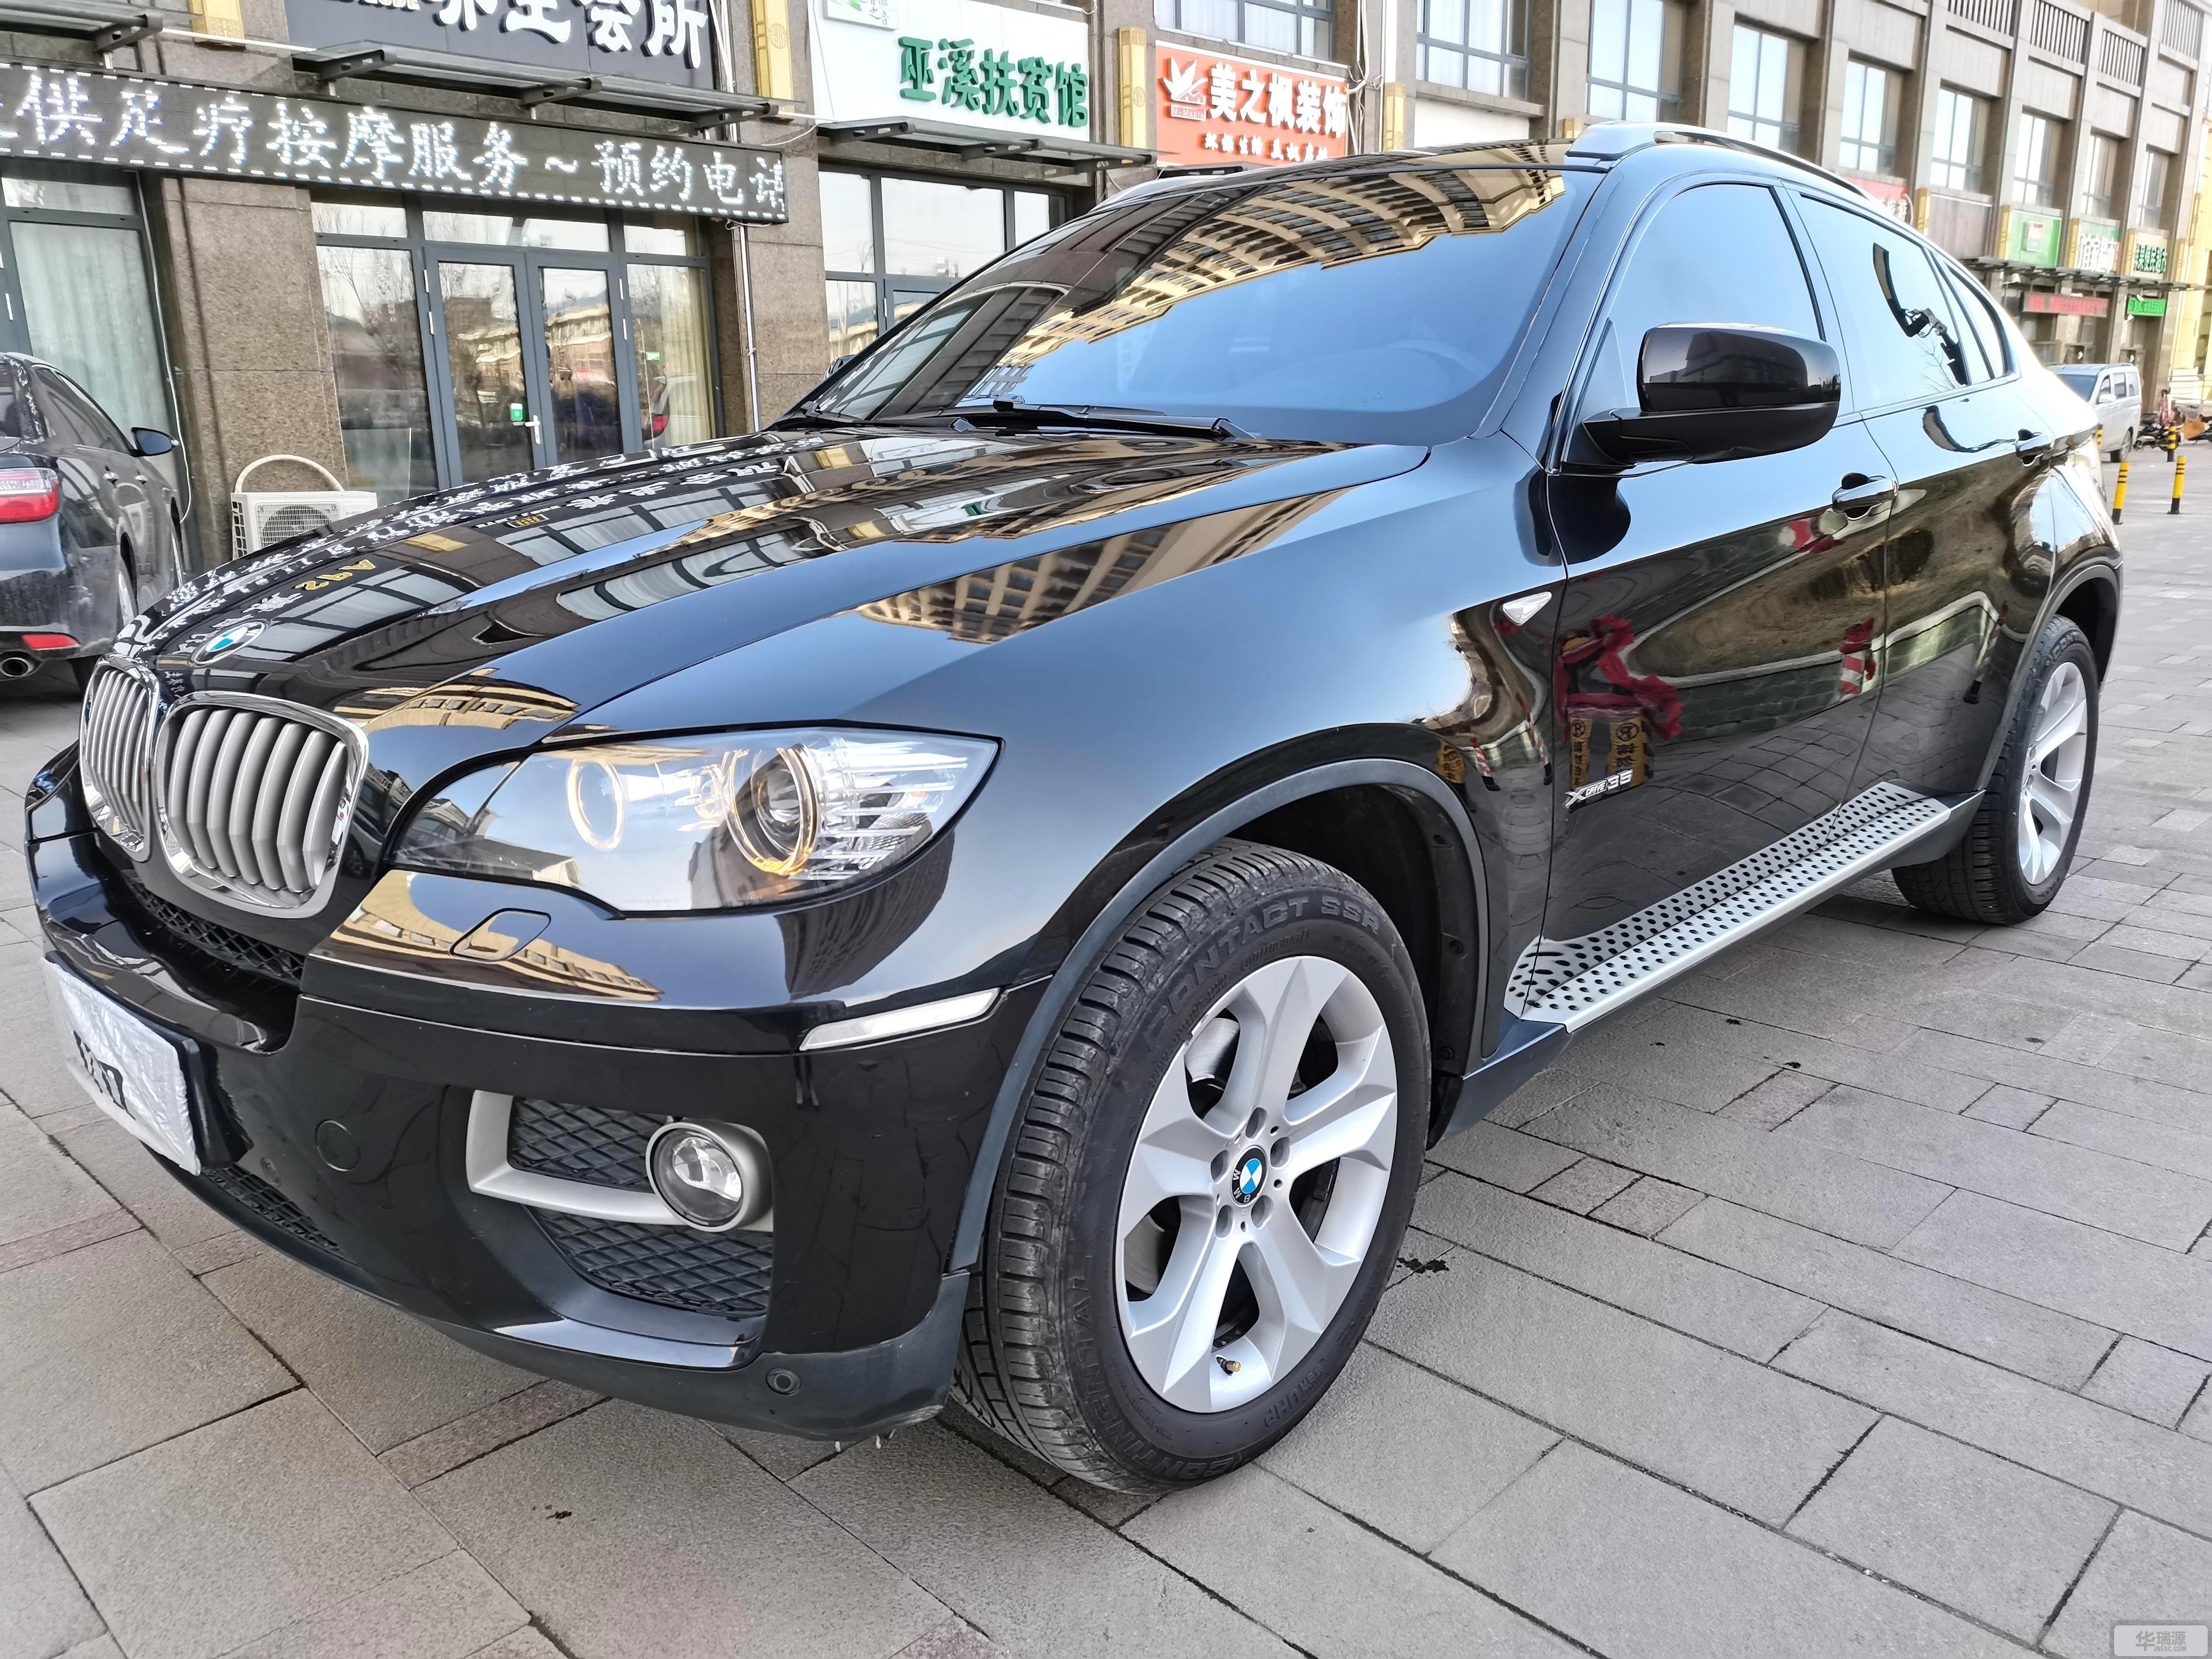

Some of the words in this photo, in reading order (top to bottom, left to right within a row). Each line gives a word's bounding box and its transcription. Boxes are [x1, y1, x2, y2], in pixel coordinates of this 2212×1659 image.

[898, 36, 1089, 127] 巫溪扶贫馆
[1320, 896, 1381, 936] SSR
